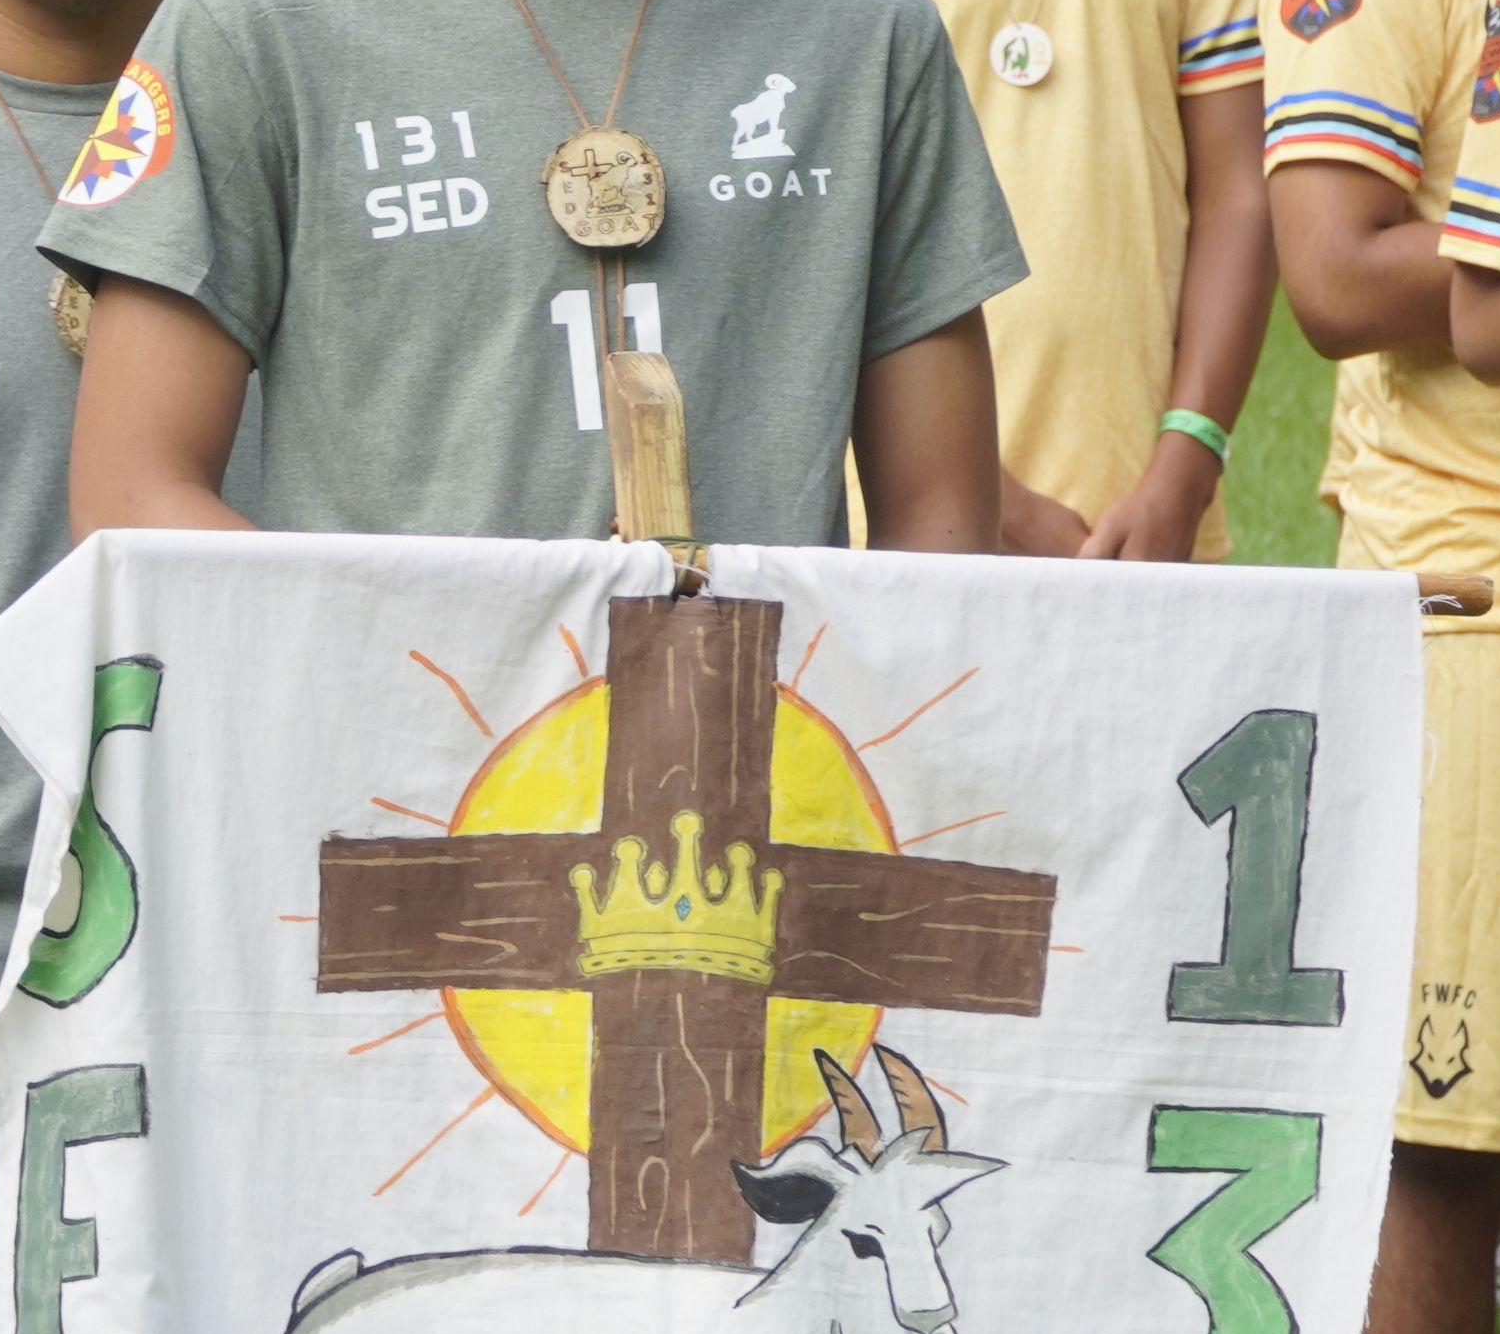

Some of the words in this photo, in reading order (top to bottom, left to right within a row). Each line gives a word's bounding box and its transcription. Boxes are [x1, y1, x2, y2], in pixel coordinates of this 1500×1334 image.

[354, 110, 478, 170] 131
[708, 167, 833, 202] GOAT
[365, 177, 490, 239] SED
[574, 213, 659, 238] GOAT
[1421, 983, 1477, 1010] FWFC
